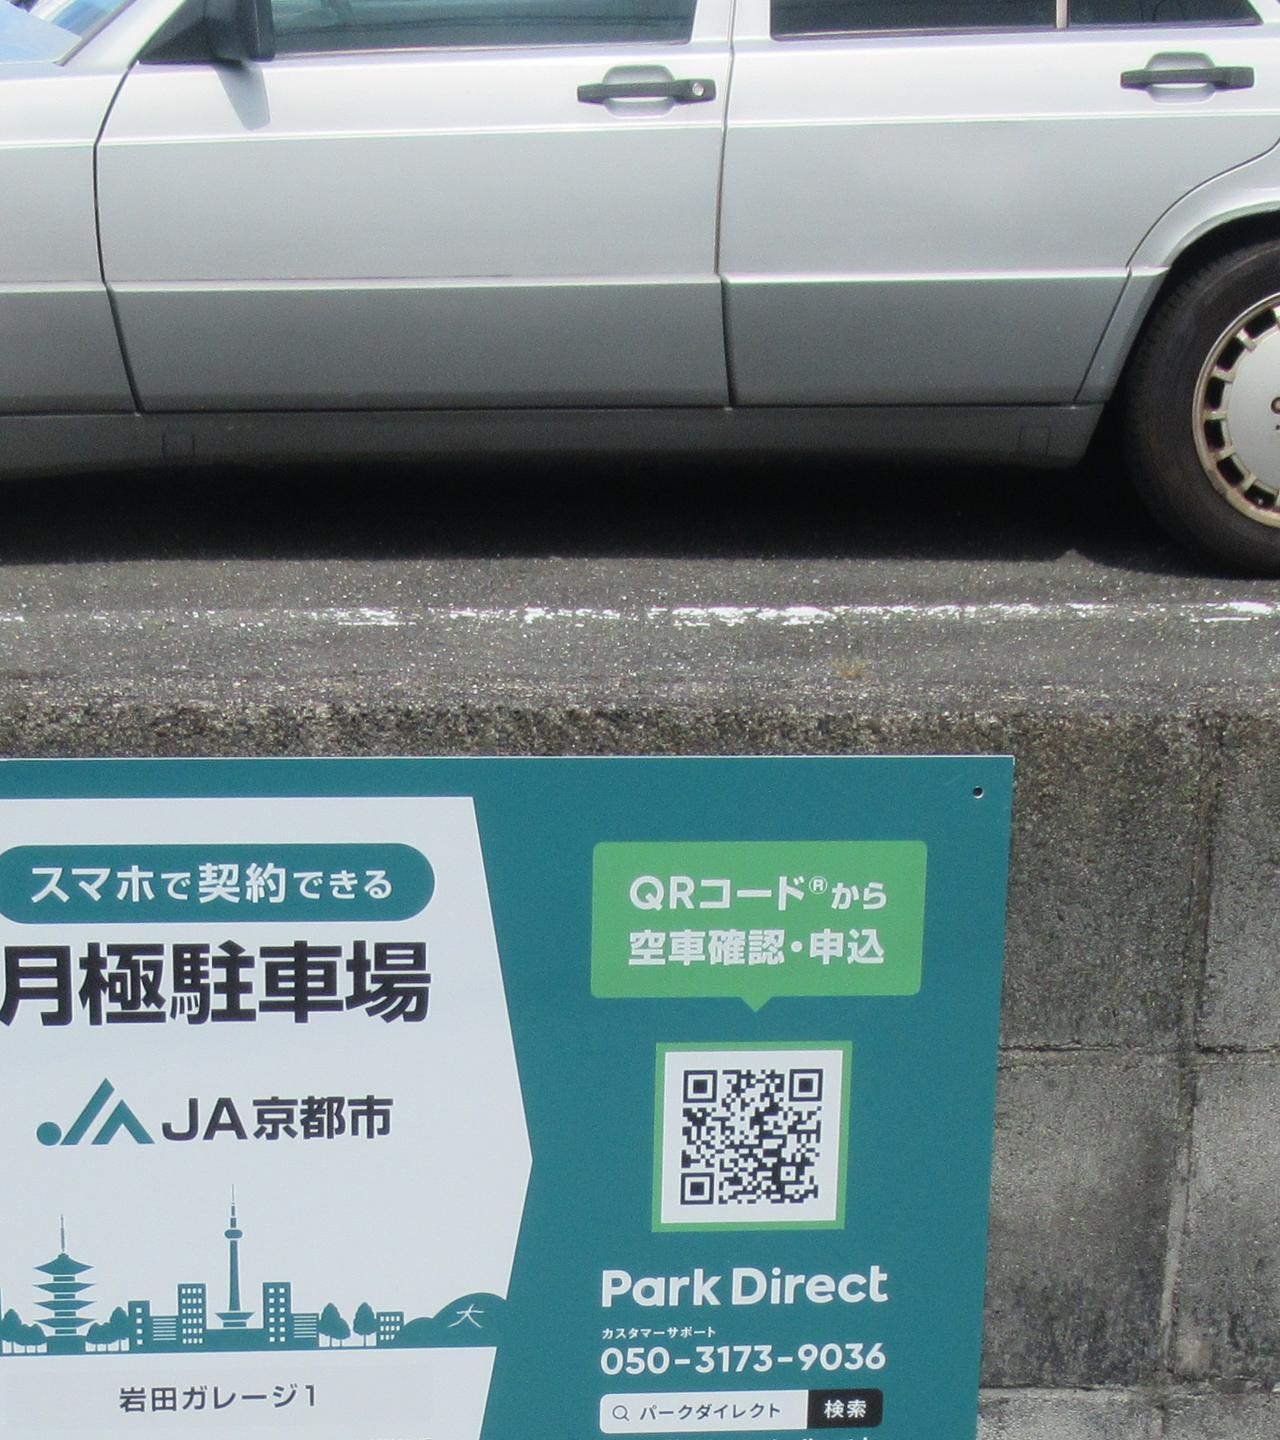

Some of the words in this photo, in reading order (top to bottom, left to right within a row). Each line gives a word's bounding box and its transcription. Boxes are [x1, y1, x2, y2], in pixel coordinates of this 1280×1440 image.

[30, 862, 392, 904] スマホで契約できる
[628, 928, 885, 967] 空車確認・申込
[601, 1268, 722, 1308] Park
[731, 1265, 889, 1306] Direct
[602, 1326, 716, 1339] カスタマーサポート
[600, 1342, 887, 1375] 050-3173-9036
[119, 1383, 317, 1413] 岩田ガレージ1
[639, 1403, 781, 1421] パークダイレクト
[823, 1398, 867, 1419] 検索
